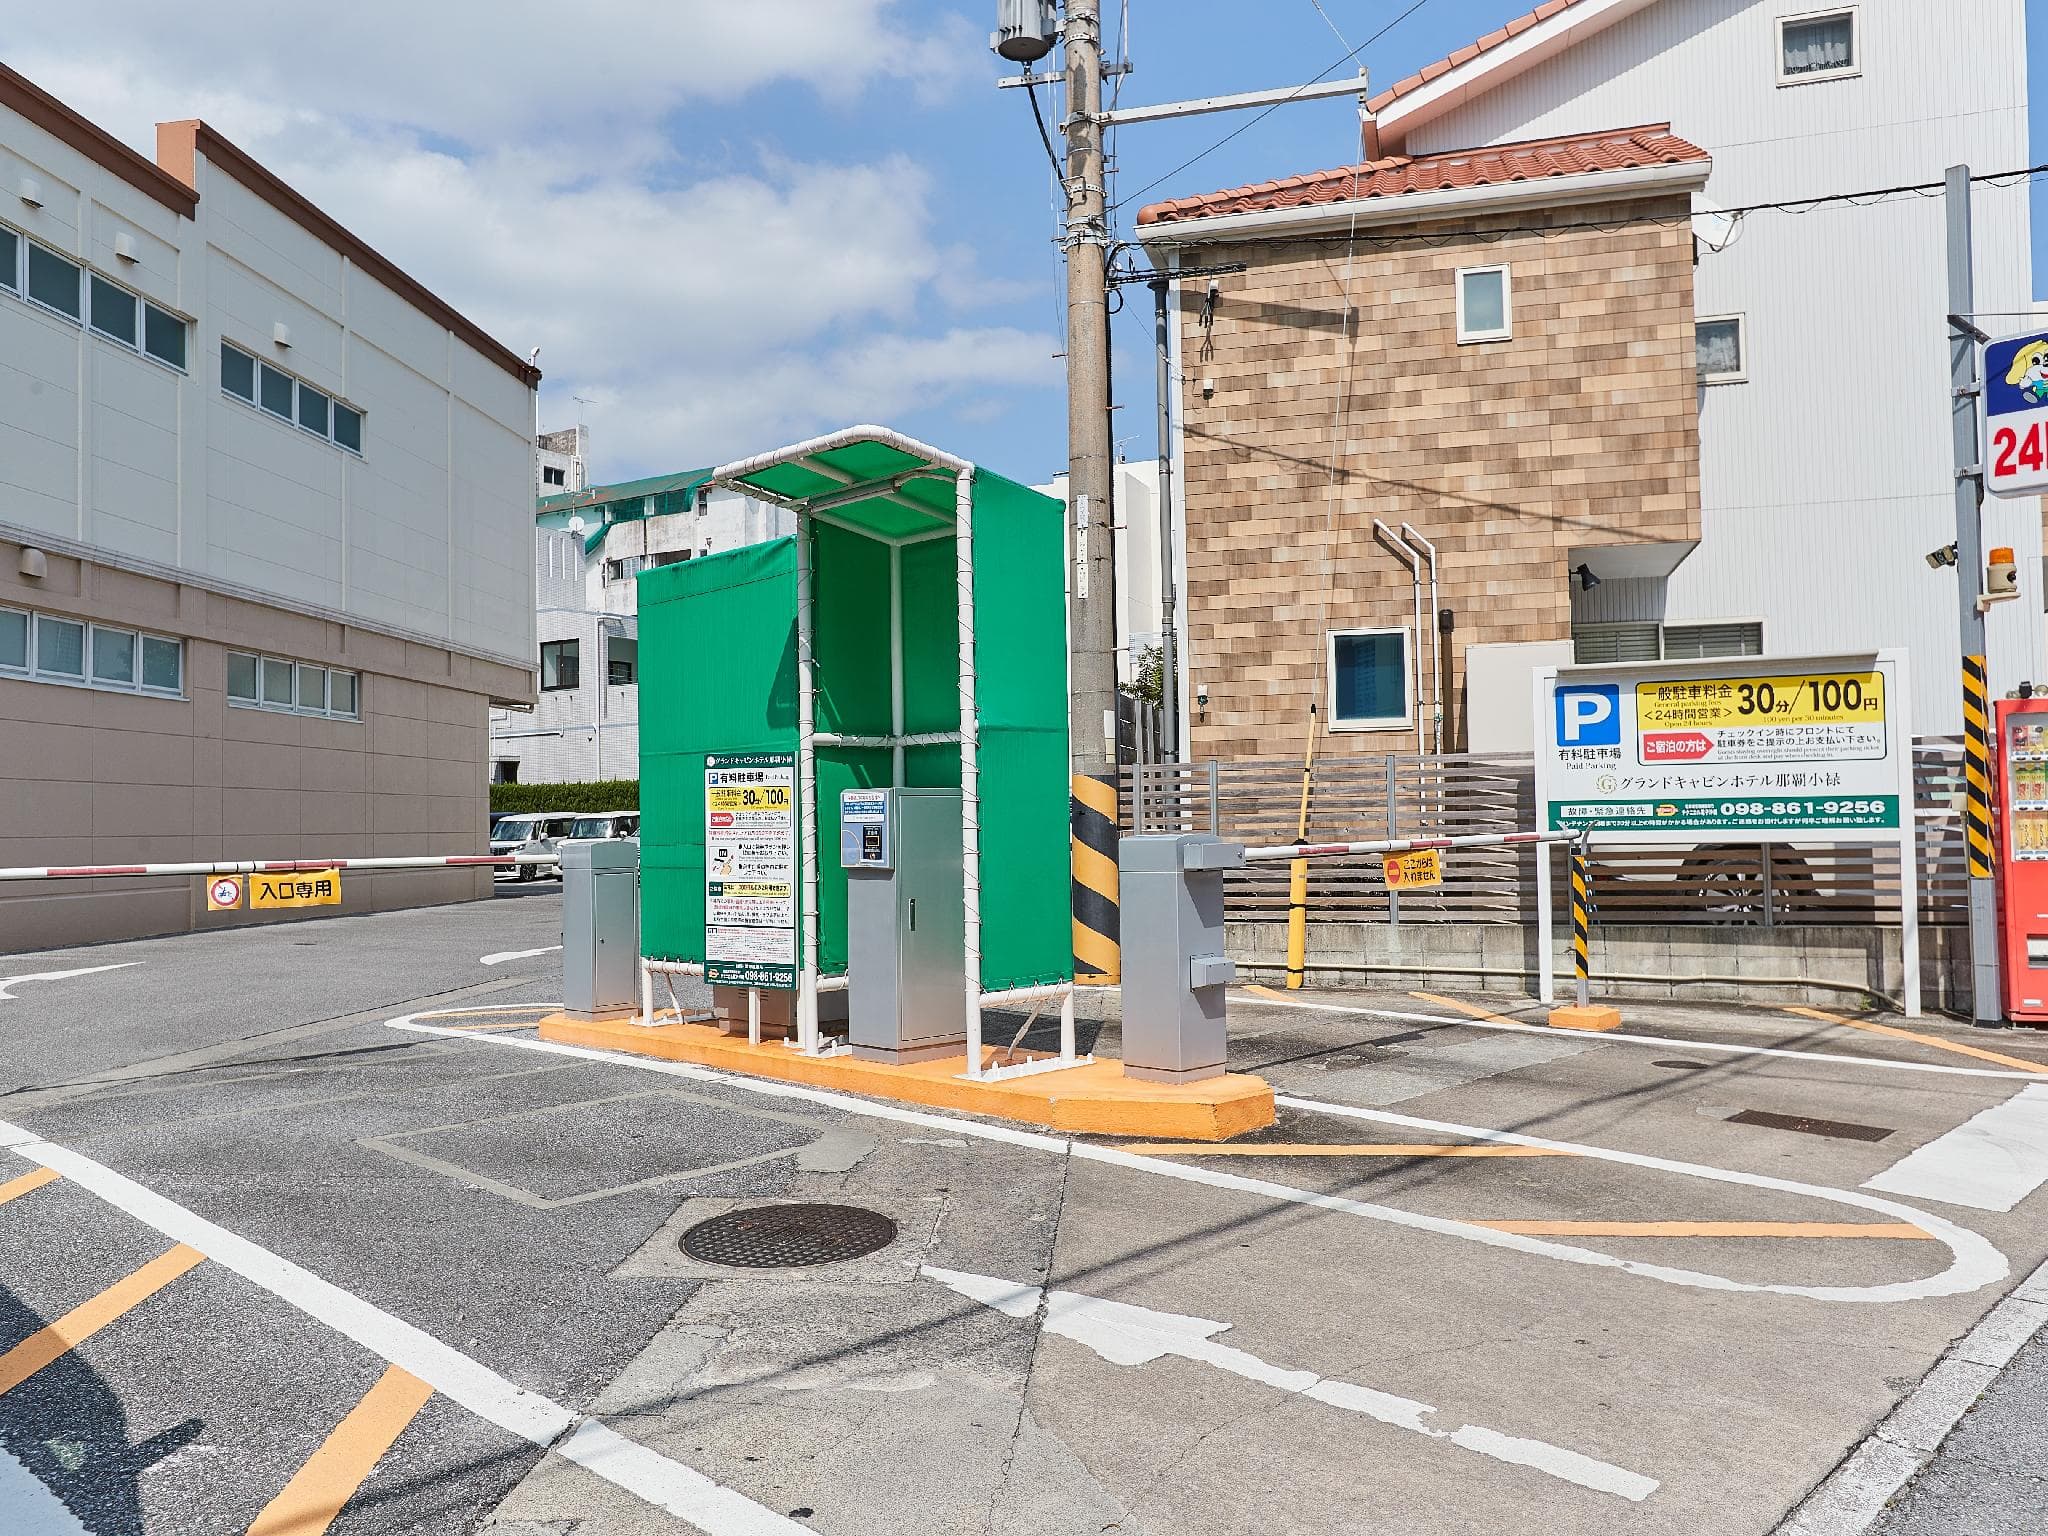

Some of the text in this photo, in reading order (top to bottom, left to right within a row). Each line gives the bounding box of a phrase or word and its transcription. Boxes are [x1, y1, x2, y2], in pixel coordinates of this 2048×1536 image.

[1993, 421, 2048, 477] 24
[1643, 684, 1733, 701] 一般駐車料金
[1558, 747, 1622, 761] 有料駐車場
[1646, 739, 1707, 753] ご宿泊の方は
[1621, 772, 1841, 789] グランドキャビンホテル那覇小禄
[1720, 800, 1886, 816] 098-861-9256
[1404, 857, 1433, 869] ここからは
[1403, 871, 1436, 883] 入れません
[260, 880, 331, 900] 入口専用
